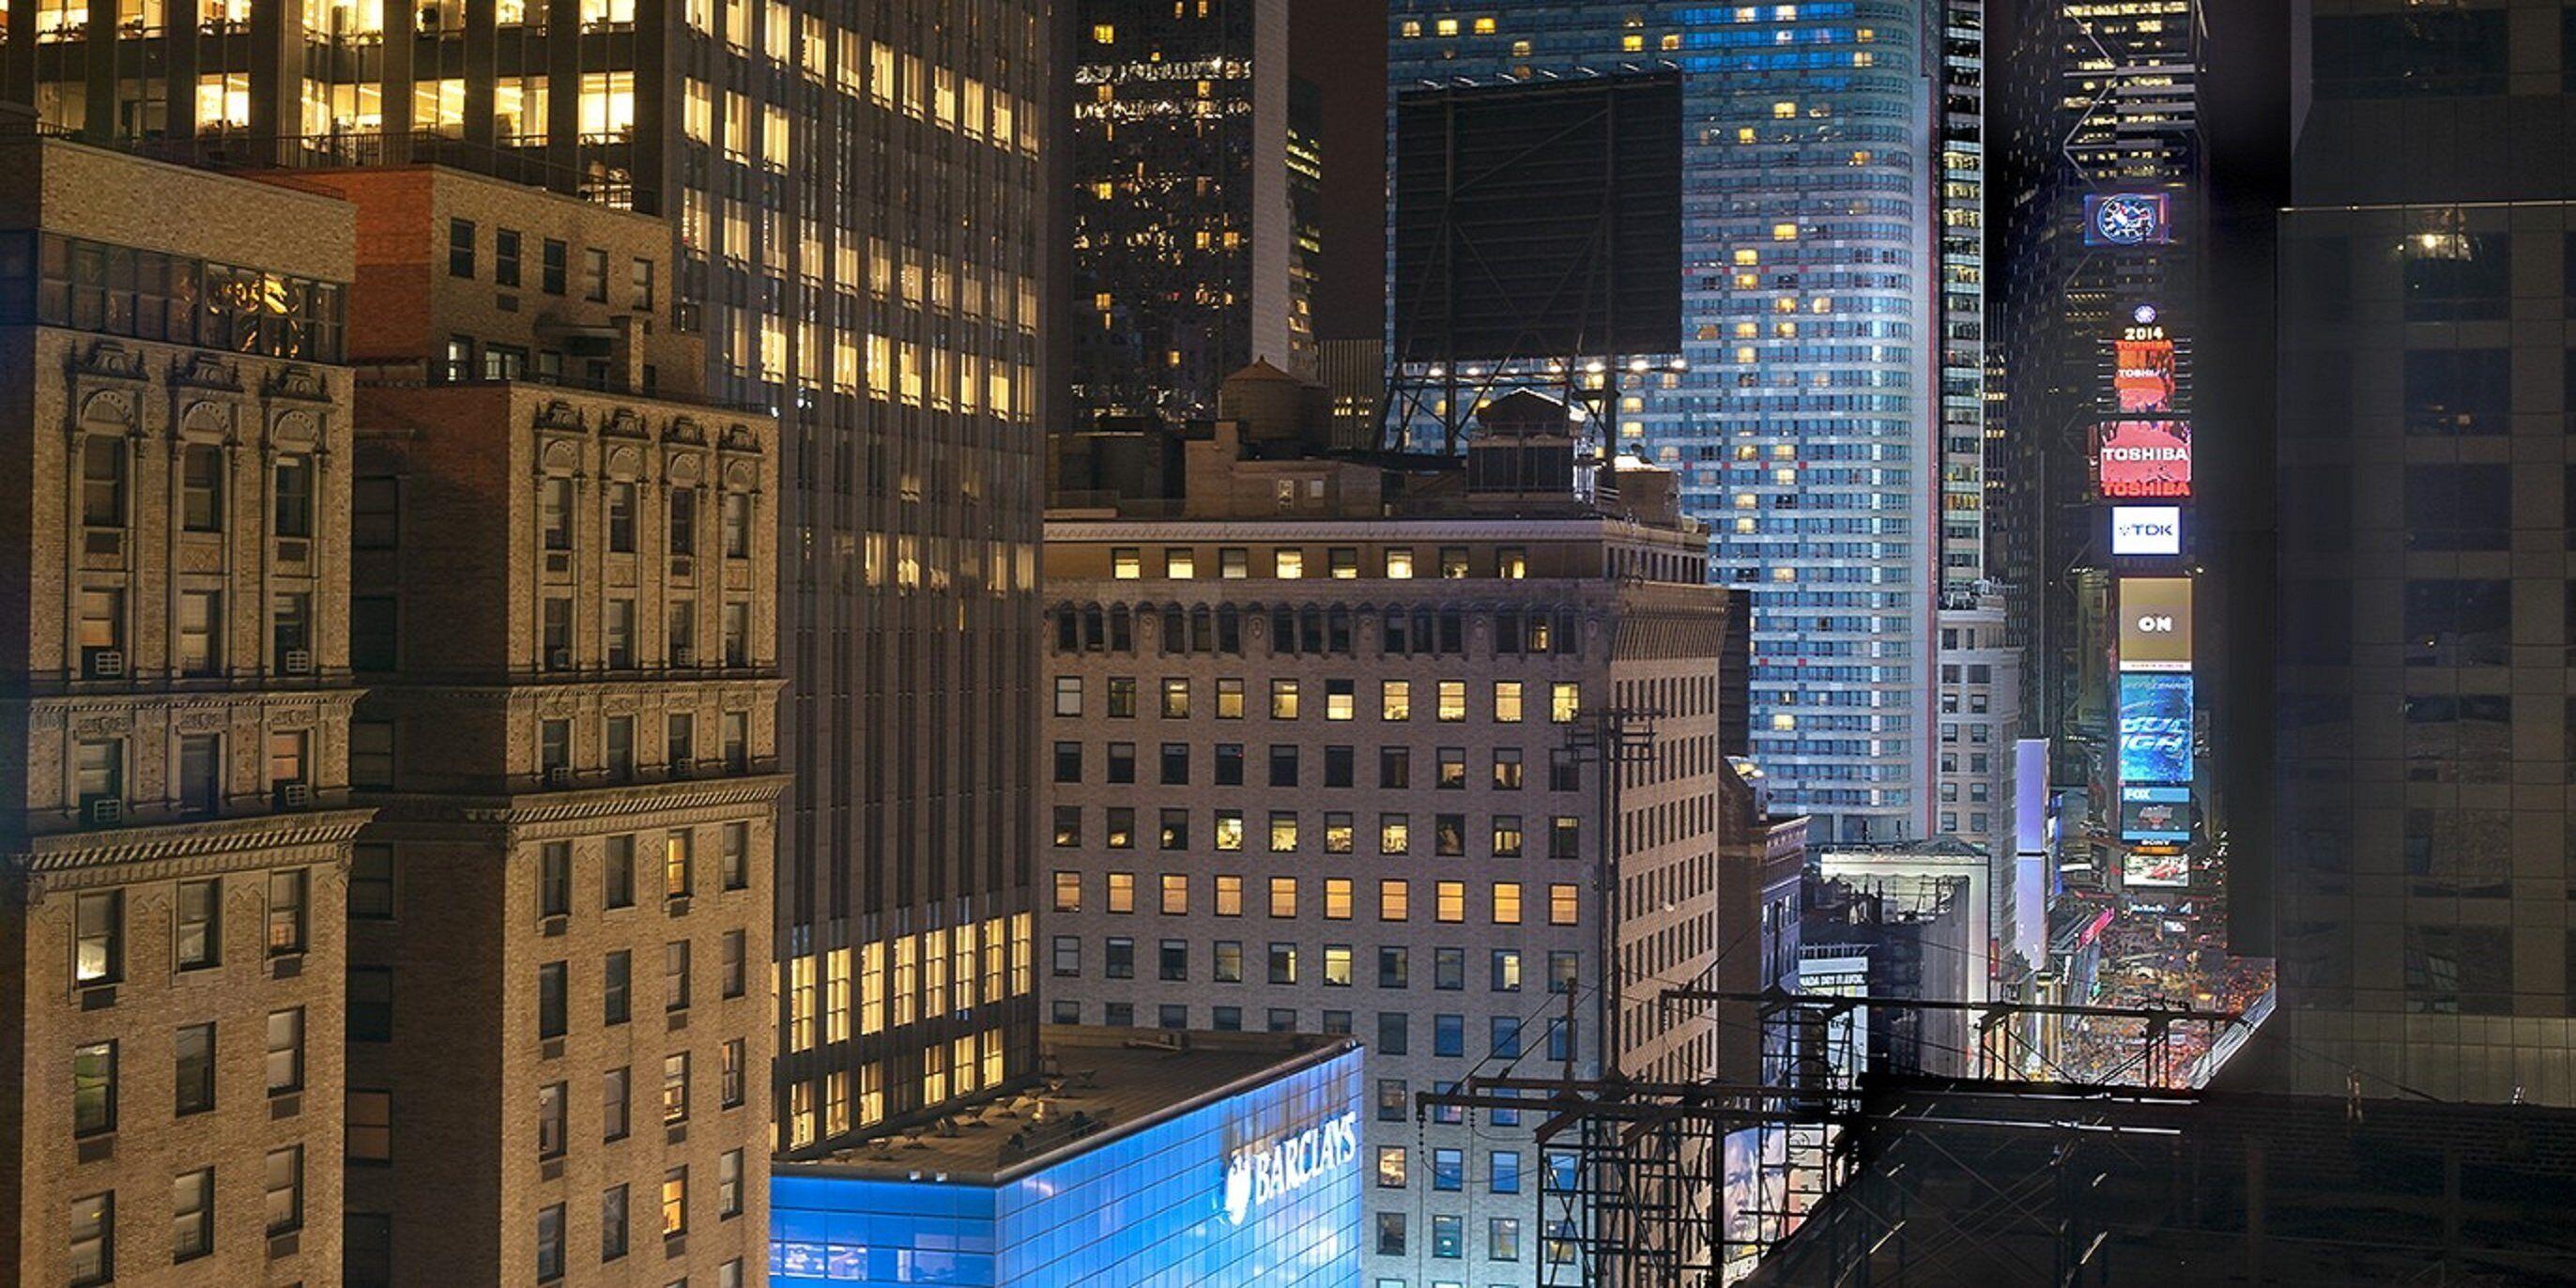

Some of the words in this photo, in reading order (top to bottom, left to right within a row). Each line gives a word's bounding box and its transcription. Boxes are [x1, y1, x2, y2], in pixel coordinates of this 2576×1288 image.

[2124, 326, 2164, 341] 2014
[2104, 448, 2189, 461] TOSHIBA
[2103, 482, 2191, 497] TOSHIBA
[2131, 524, 2173, 536] TDK
[2138, 616, 2173, 632] ON
[2124, 789, 2151, 800] FOX
[1254, 1111, 1357, 1206] BARCLAYS
